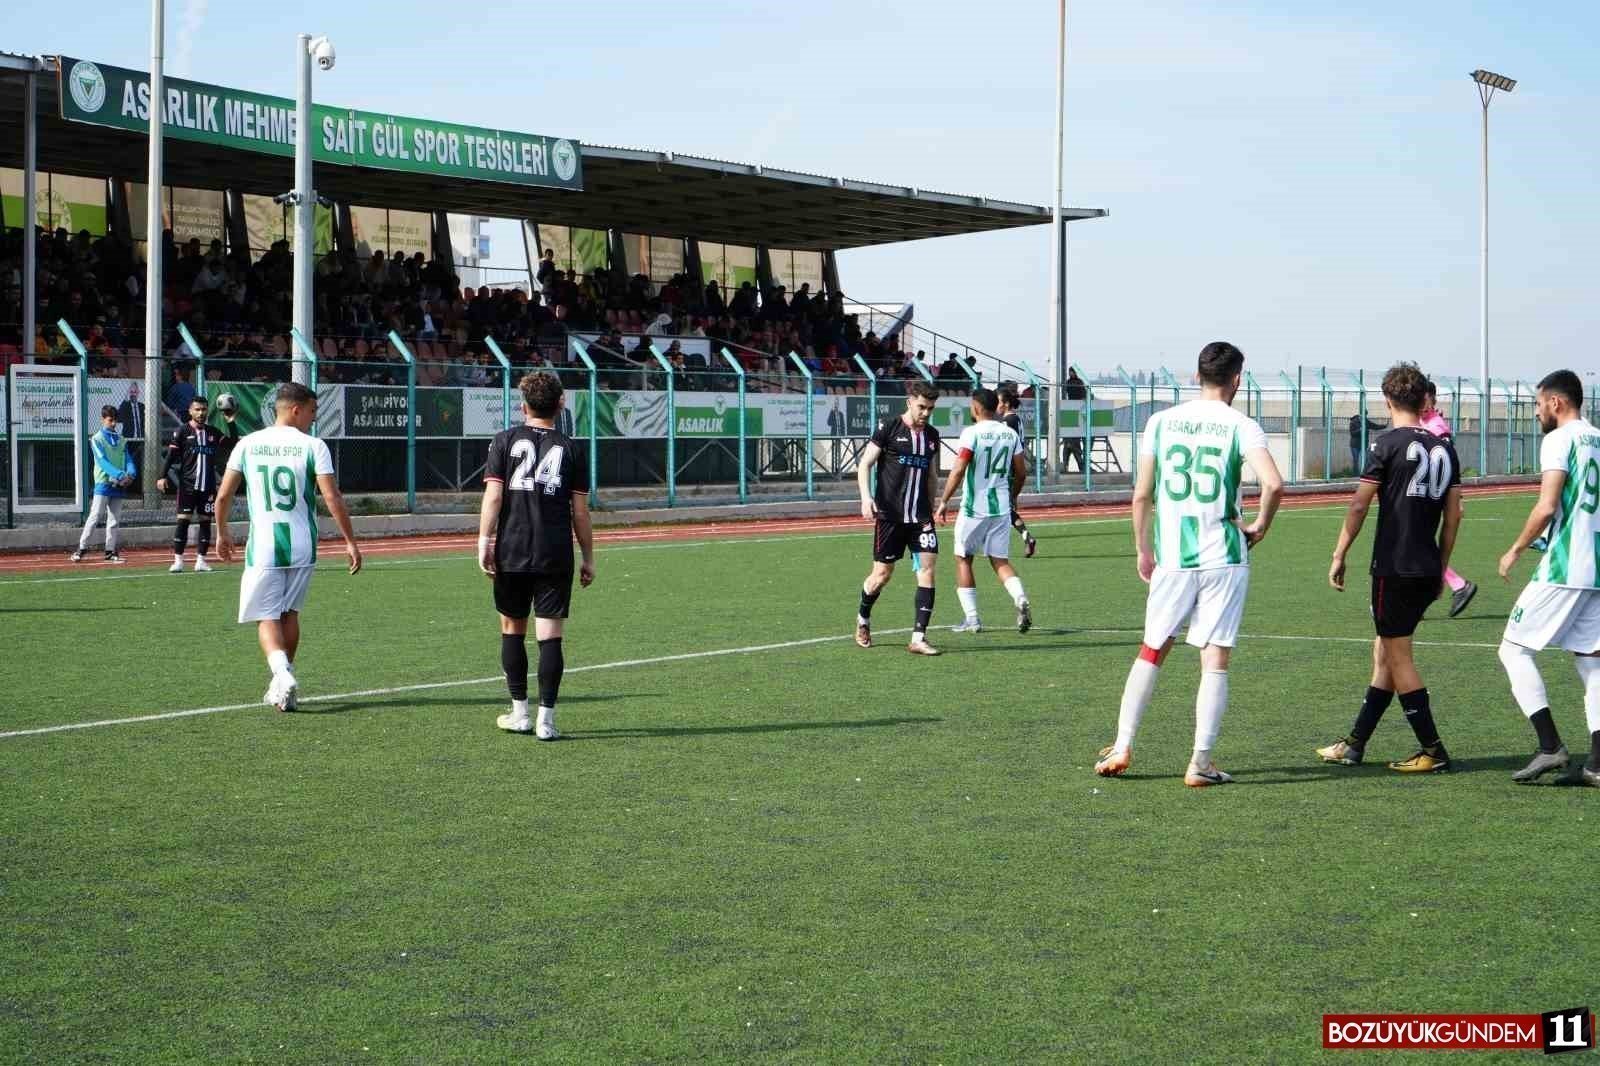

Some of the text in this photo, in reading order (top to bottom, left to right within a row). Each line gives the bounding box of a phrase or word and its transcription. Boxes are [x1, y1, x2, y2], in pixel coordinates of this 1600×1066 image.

[121, 80, 218, 132] ASRLIK
[224, 98, 297, 146] MEHME
[322, 111, 366, 154] SAİT
[372, 116, 409, 160] GÜL
[414, 128, 461, 166] SPOR
[464, 131, 548, 176] TESİSLERİ
[396, 414, 422, 427] SPR
[677, 417, 724, 433] ASARLIK
[509, 439, 564, 496] 24
[984, 446, 1009, 479] 14
[1165, 445, 1222, 503] 35
[1406, 440, 1452, 500] 20
[256, 464, 297, 511] 19
[919, 533, 937, 549] 99
